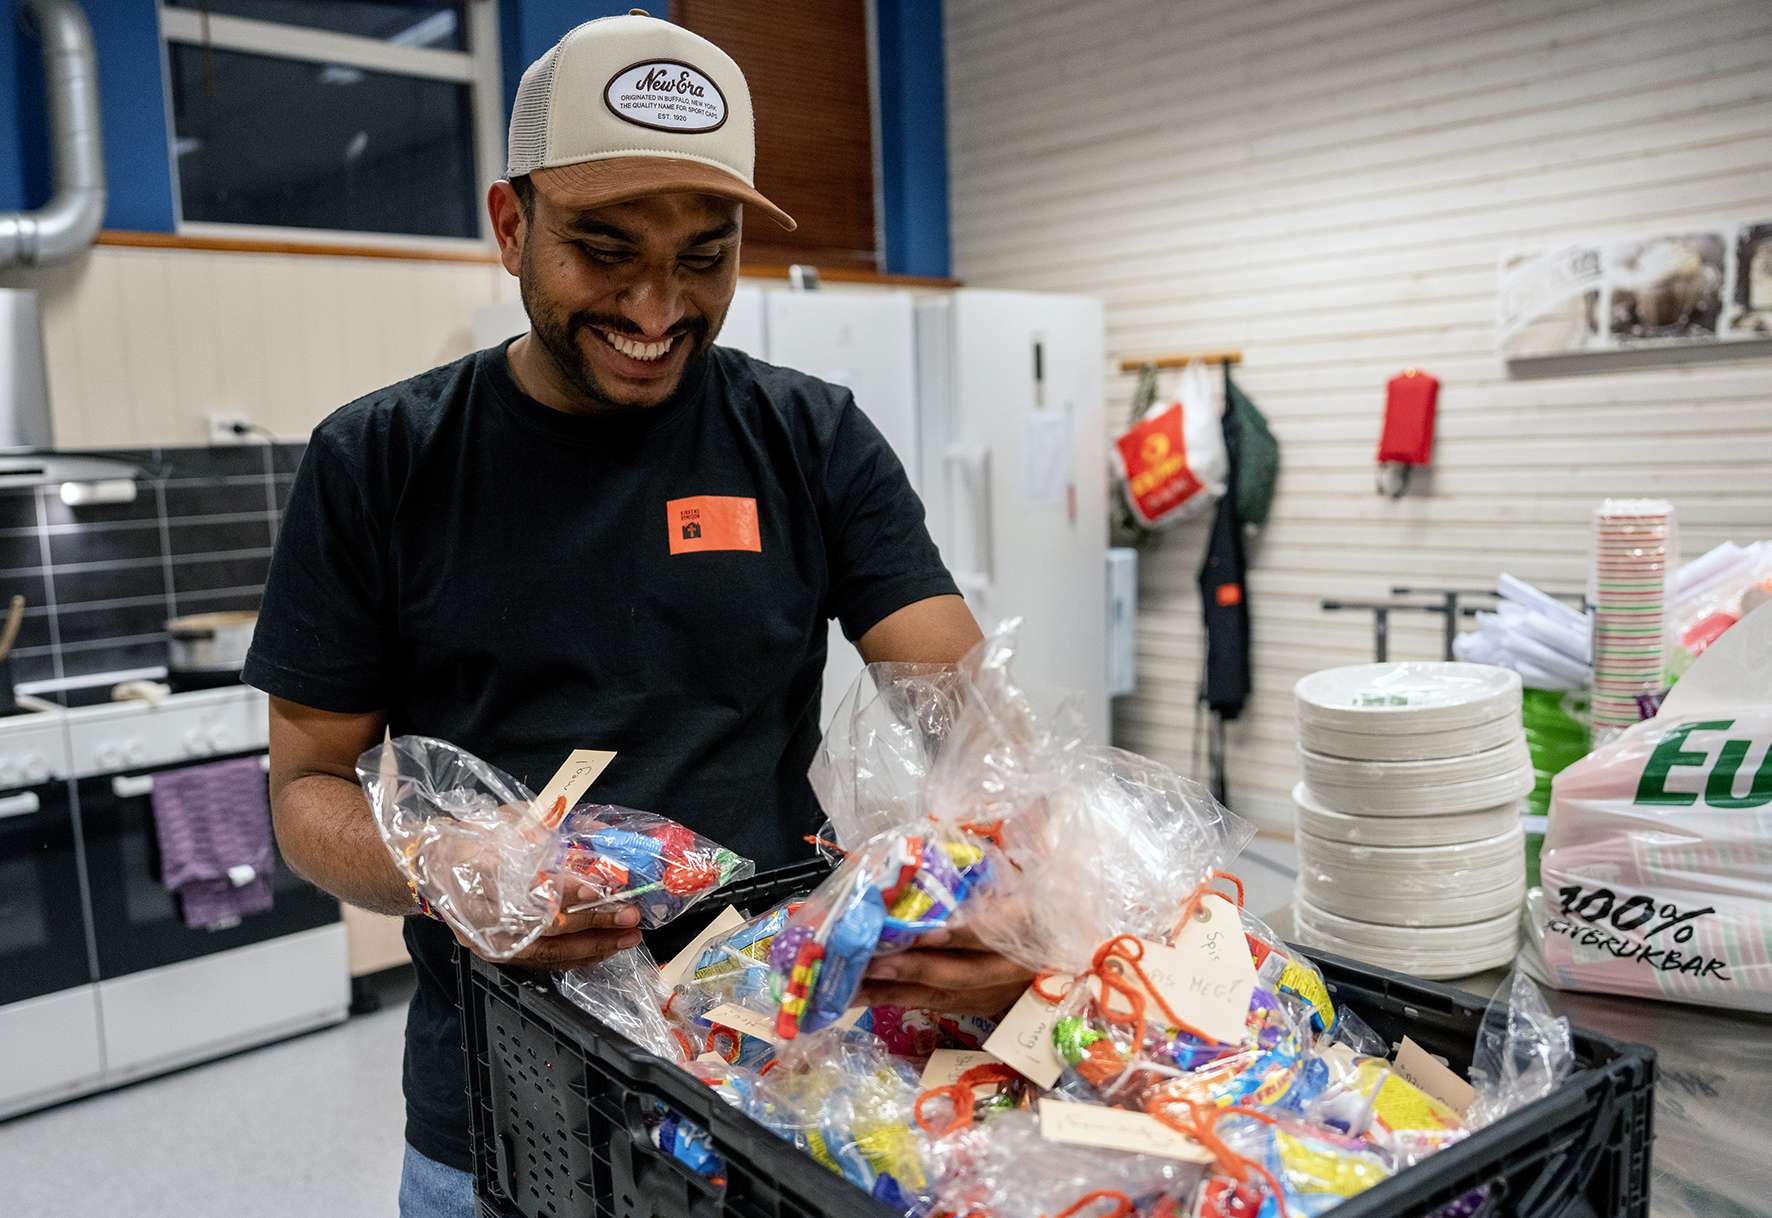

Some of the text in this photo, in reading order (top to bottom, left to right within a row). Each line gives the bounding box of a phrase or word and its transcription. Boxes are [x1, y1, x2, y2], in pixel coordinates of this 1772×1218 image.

[636, 67, 704, 98] New Era
[664, 96, 691, 105] BUFFALO,
[657, 112, 687, 122] EST. 1920
[688, 106, 705, 115] SPORT
[705, 111, 718, 120] CAPS
[1559, 884, 1716, 943] 100%
